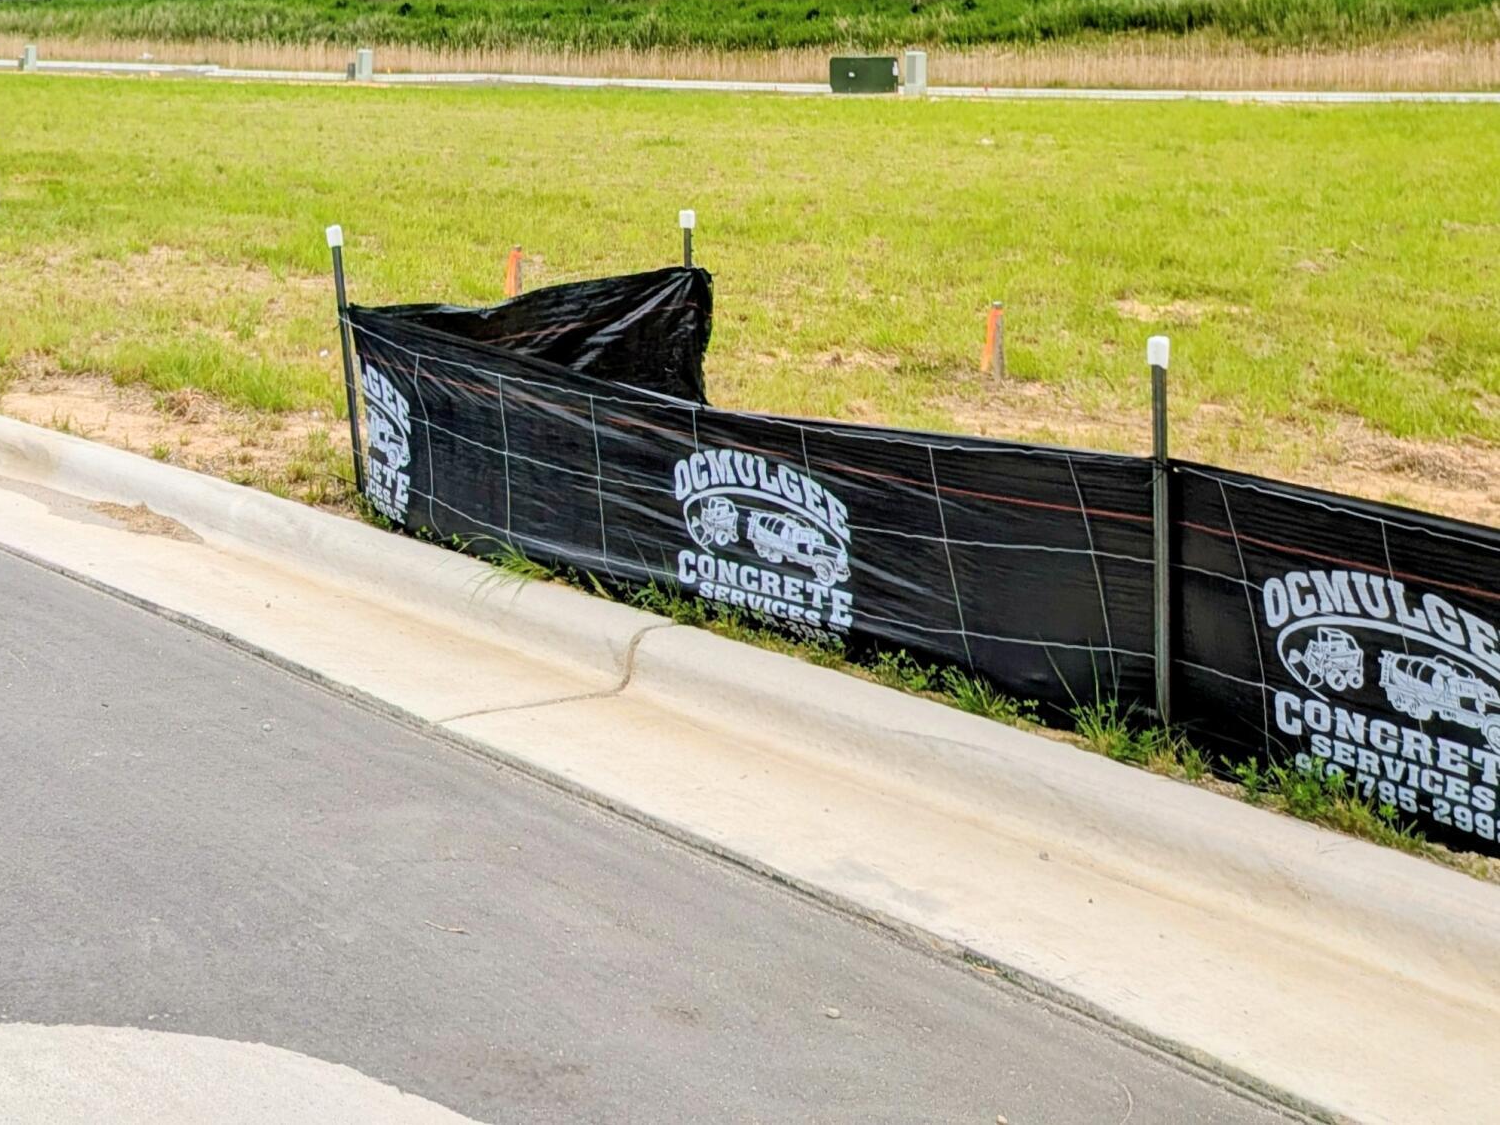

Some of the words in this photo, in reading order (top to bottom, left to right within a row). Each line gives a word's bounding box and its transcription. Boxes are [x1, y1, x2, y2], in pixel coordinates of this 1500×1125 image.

[368, 456, 411, 505] ETE
[674, 449, 852, 545] OCMULGEE
[678, 549, 853, 628] CONCRETE
[699, 581, 822, 627] SERVICES
[1263, 570, 1500, 673] OCMULGE
[1310, 734, 1497, 812] SERVICES
